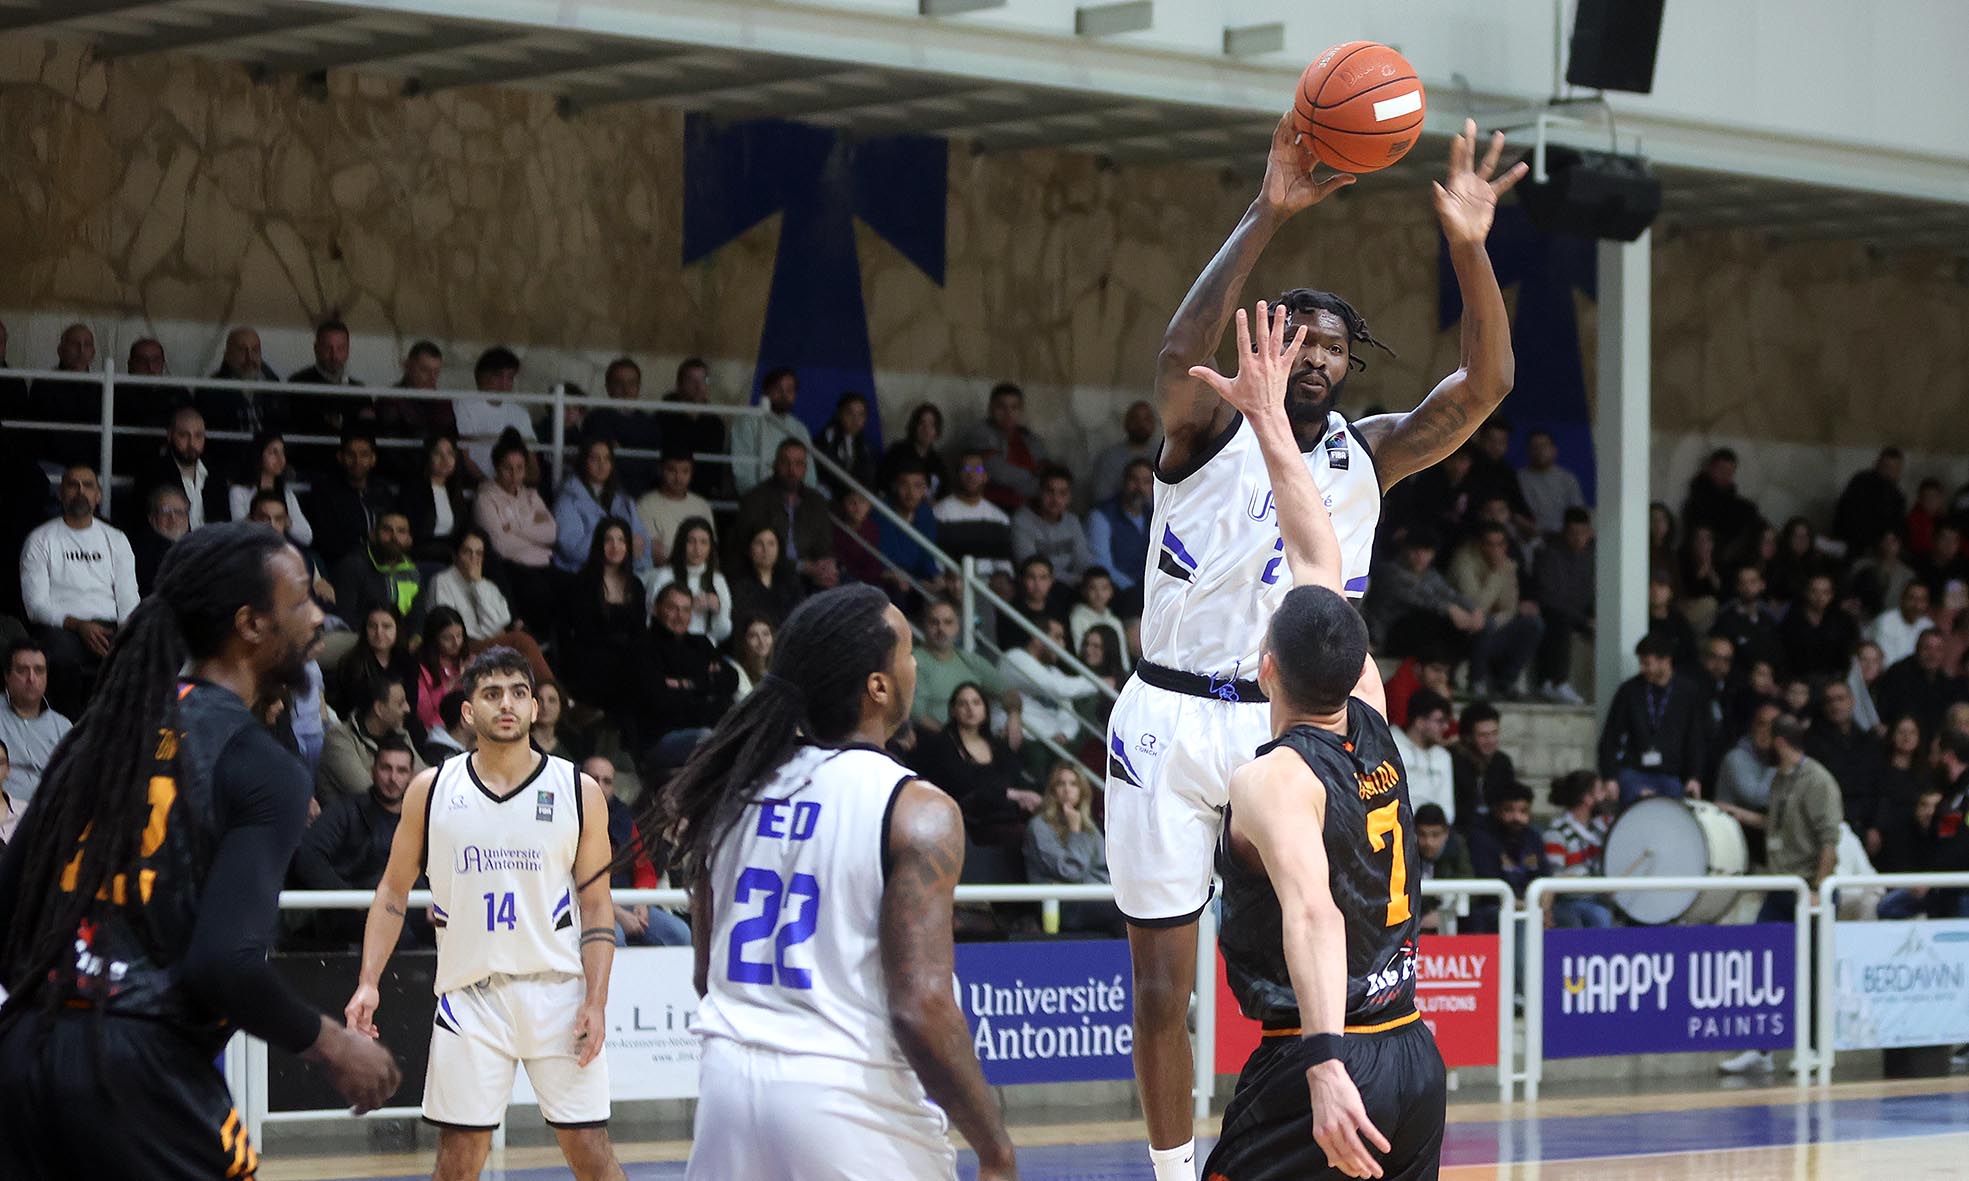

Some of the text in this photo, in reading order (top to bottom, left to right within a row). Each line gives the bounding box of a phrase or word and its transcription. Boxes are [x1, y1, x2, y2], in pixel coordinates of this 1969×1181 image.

[1331, 451, 1346, 459] FIBA
[757, 797, 822, 840] ED
[1366, 798, 1412, 927] 7
[484, 892, 517, 931] 14
[727, 866, 820, 990] 22
[969, 974, 1125, 1016] Université
[1562, 949, 1785, 1015] HAPPY WALL
[974, 1015, 1134, 1061] Antonine
[1687, 1013, 1785, 1039] PAINTS
